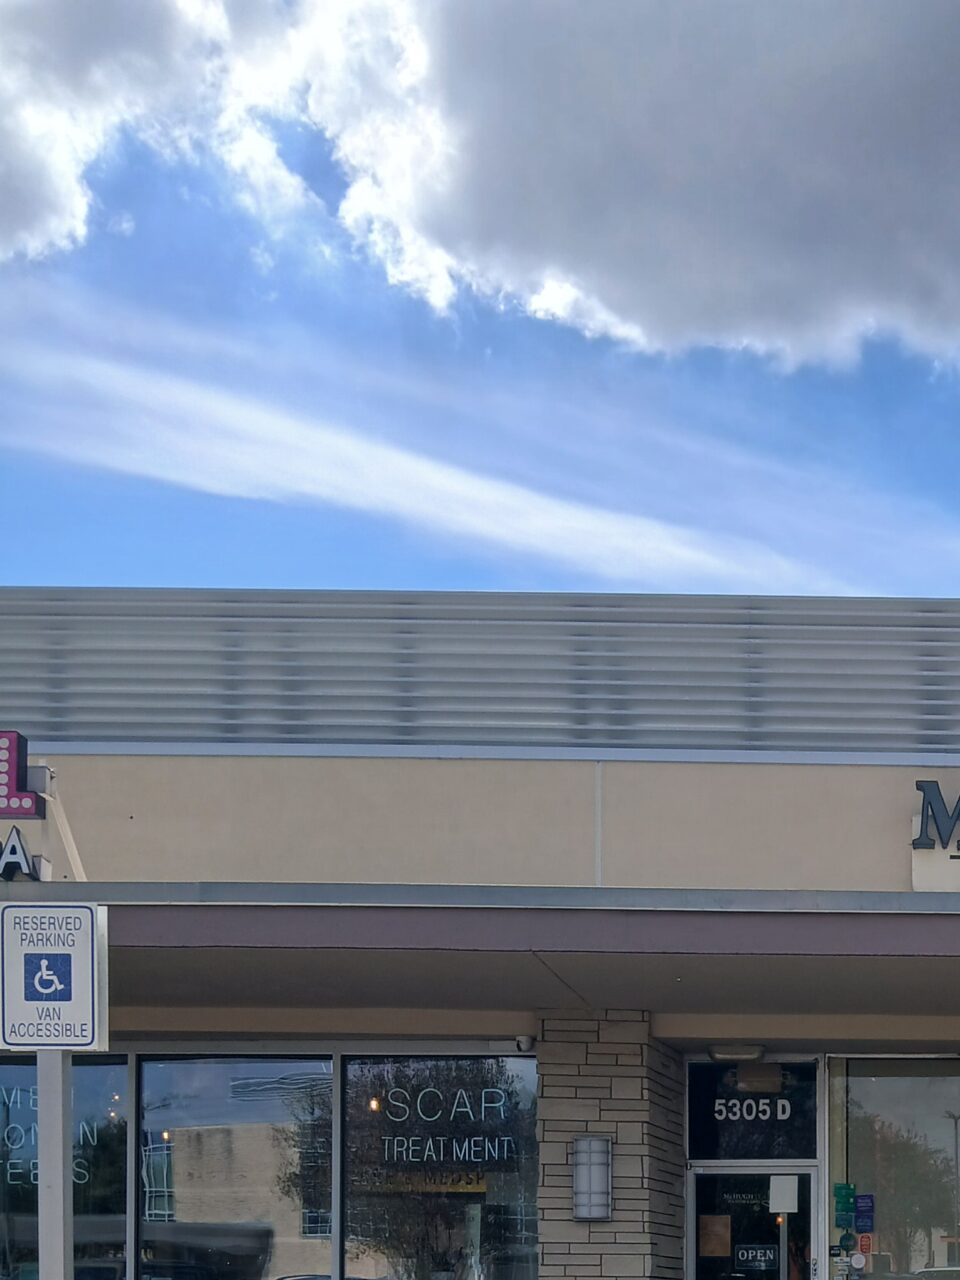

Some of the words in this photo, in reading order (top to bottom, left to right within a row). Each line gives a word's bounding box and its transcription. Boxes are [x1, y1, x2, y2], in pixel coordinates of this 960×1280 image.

[0, 825, 32, 876] A
[13, 916, 82, 930] RESERVED
[20, 933, 75, 947] PARKING
[36, 1007, 61, 1020] VAN
[9, 1023, 88, 1037] ACCESSIBLE
[386, 1088, 505, 1121] SCAR
[714, 1099, 771, 1120] 5305
[776, 1099, 791, 1120] D
[381, 1136, 514, 1162] TREATMENT
[738, 1249, 774, 1260] OPEN
